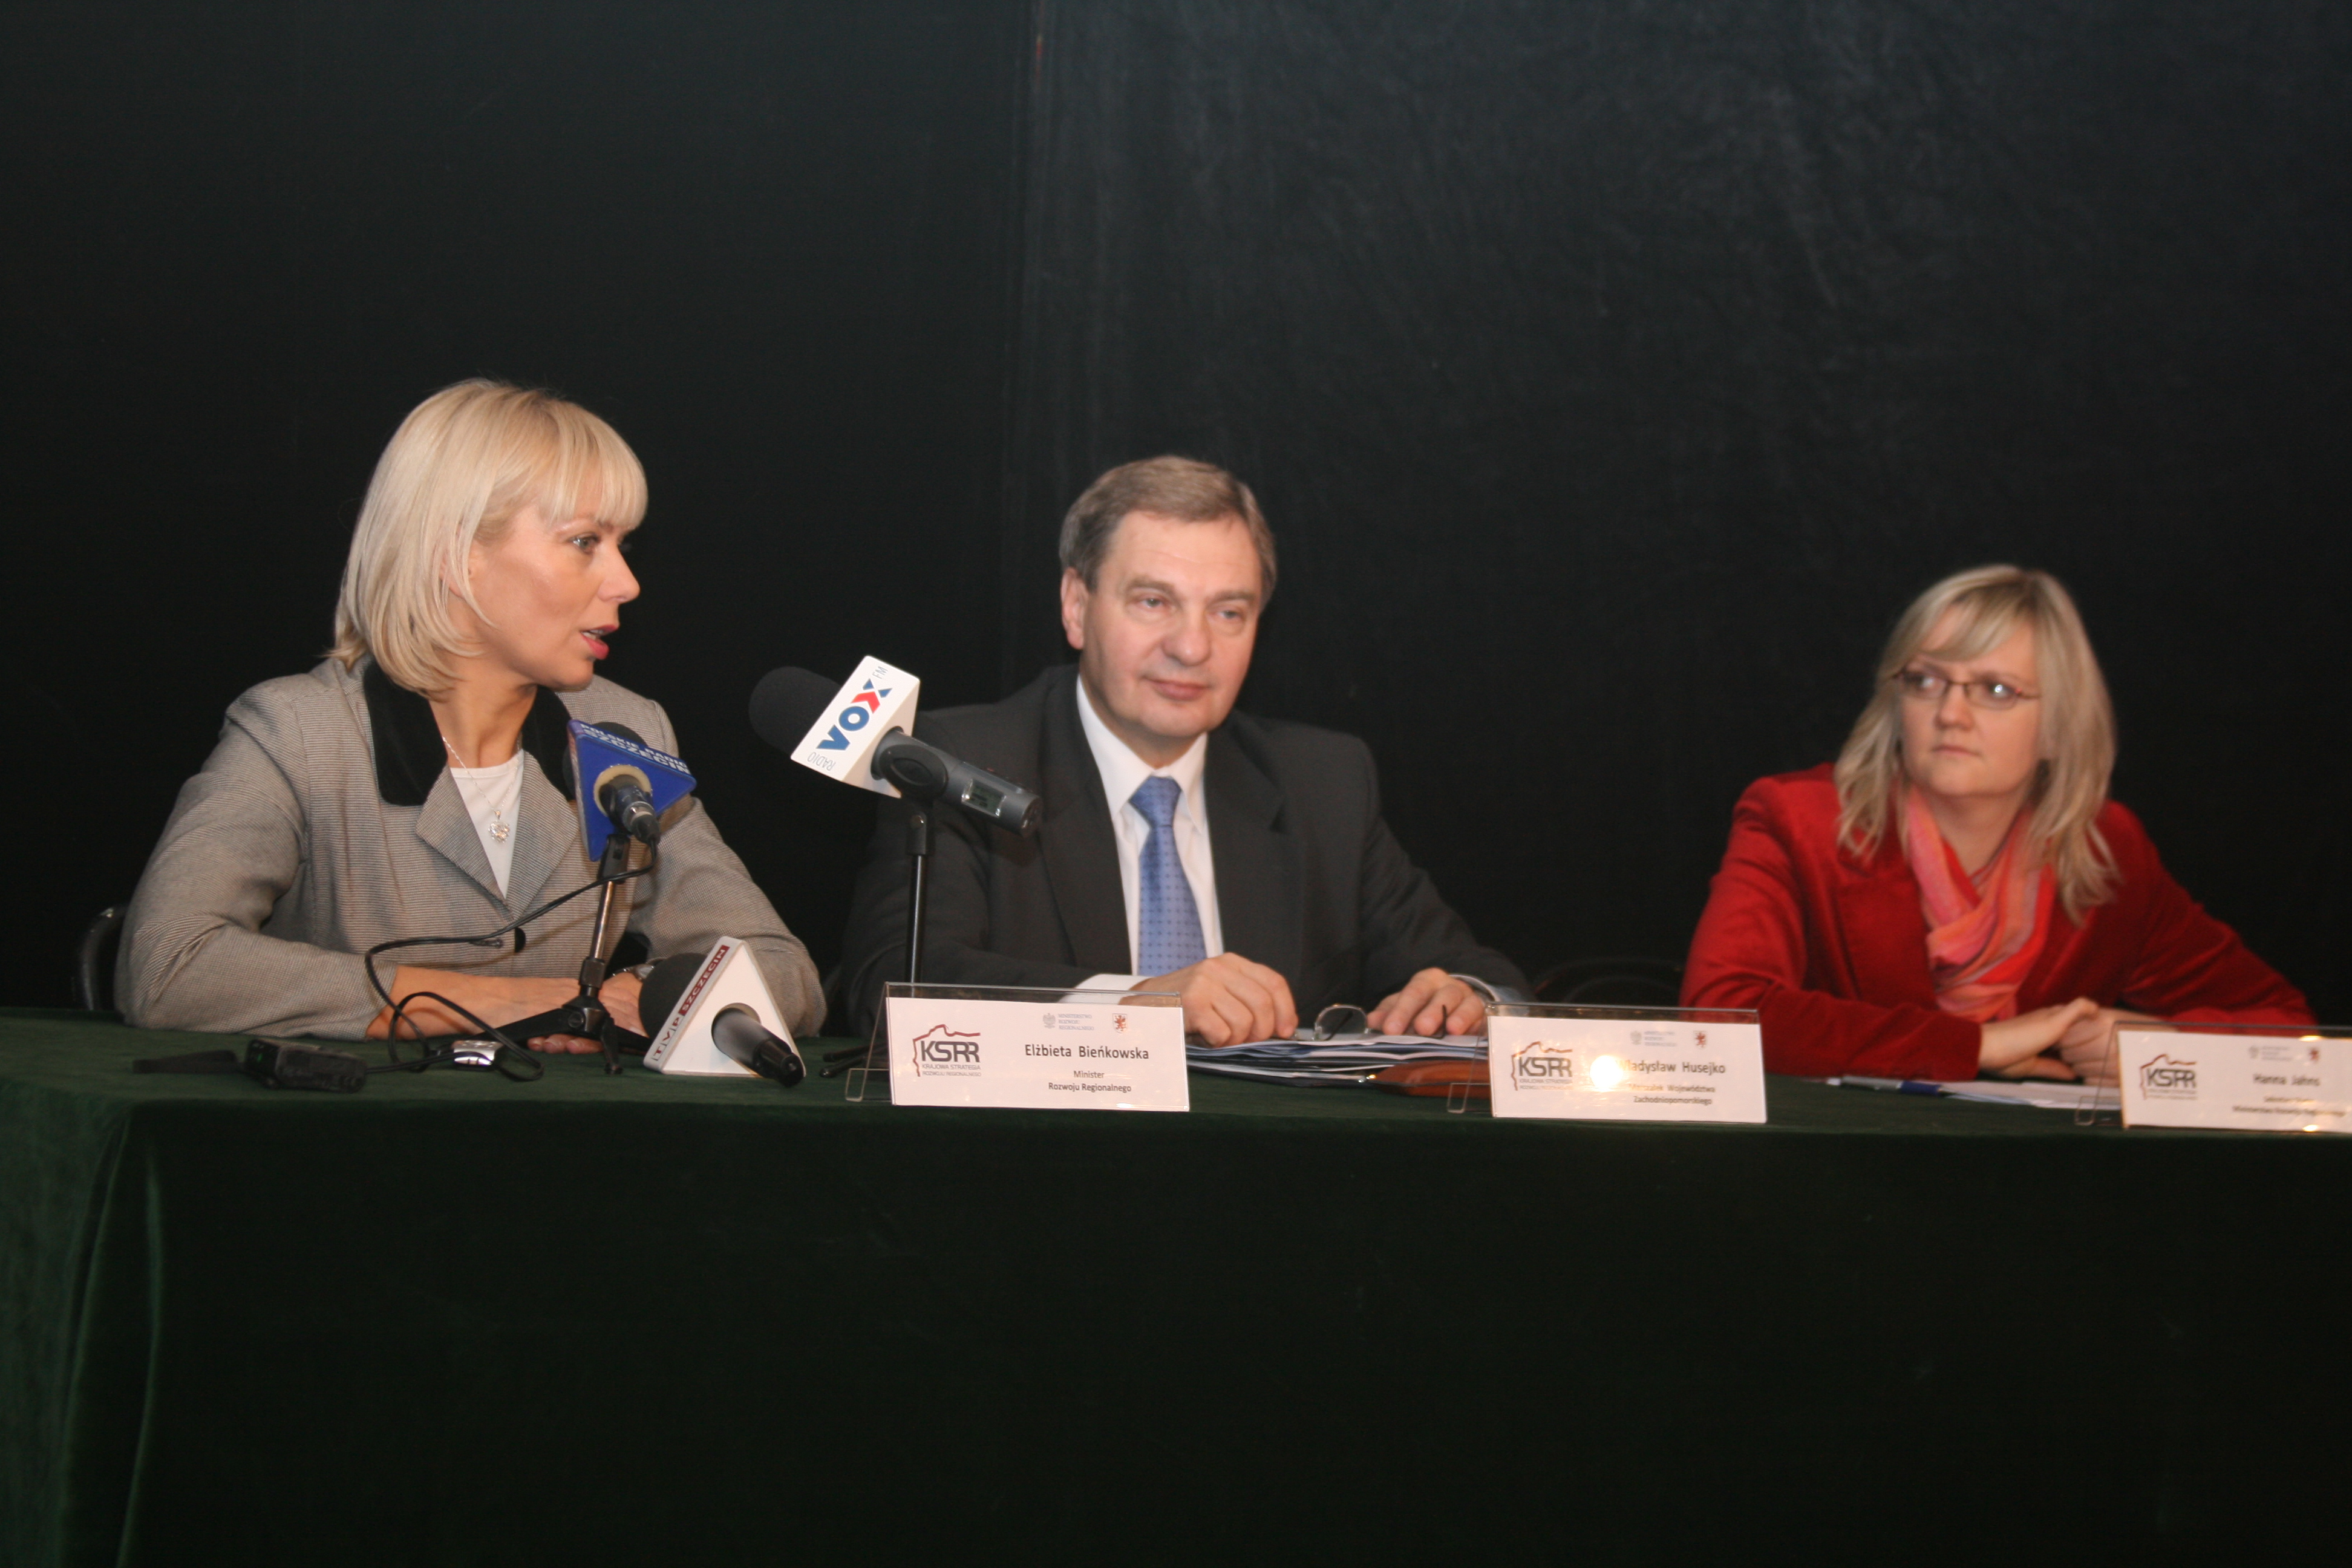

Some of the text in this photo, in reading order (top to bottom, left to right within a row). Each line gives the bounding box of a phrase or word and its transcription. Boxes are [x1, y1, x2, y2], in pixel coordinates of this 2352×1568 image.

[872, 666, 888, 679] FM
[815, 678, 892, 750] VOX
[584, 728, 691, 775] SZCZECIN
[807, 752, 836, 771] RADIO
[653, 948, 727, 1057] TVP SZCZECIN
[921, 1040, 980, 1062] KSRR
[1025, 1044, 1149, 1059] Elżbieta Bieńkowska
[1073, 1070, 1105, 1079] Minister
[1518, 1057, 1572, 1077] KSRR
[1682, 1062, 1726, 1076] Husejko
[1048, 1082, 1132, 1093] Rozwoju Regionalnego
